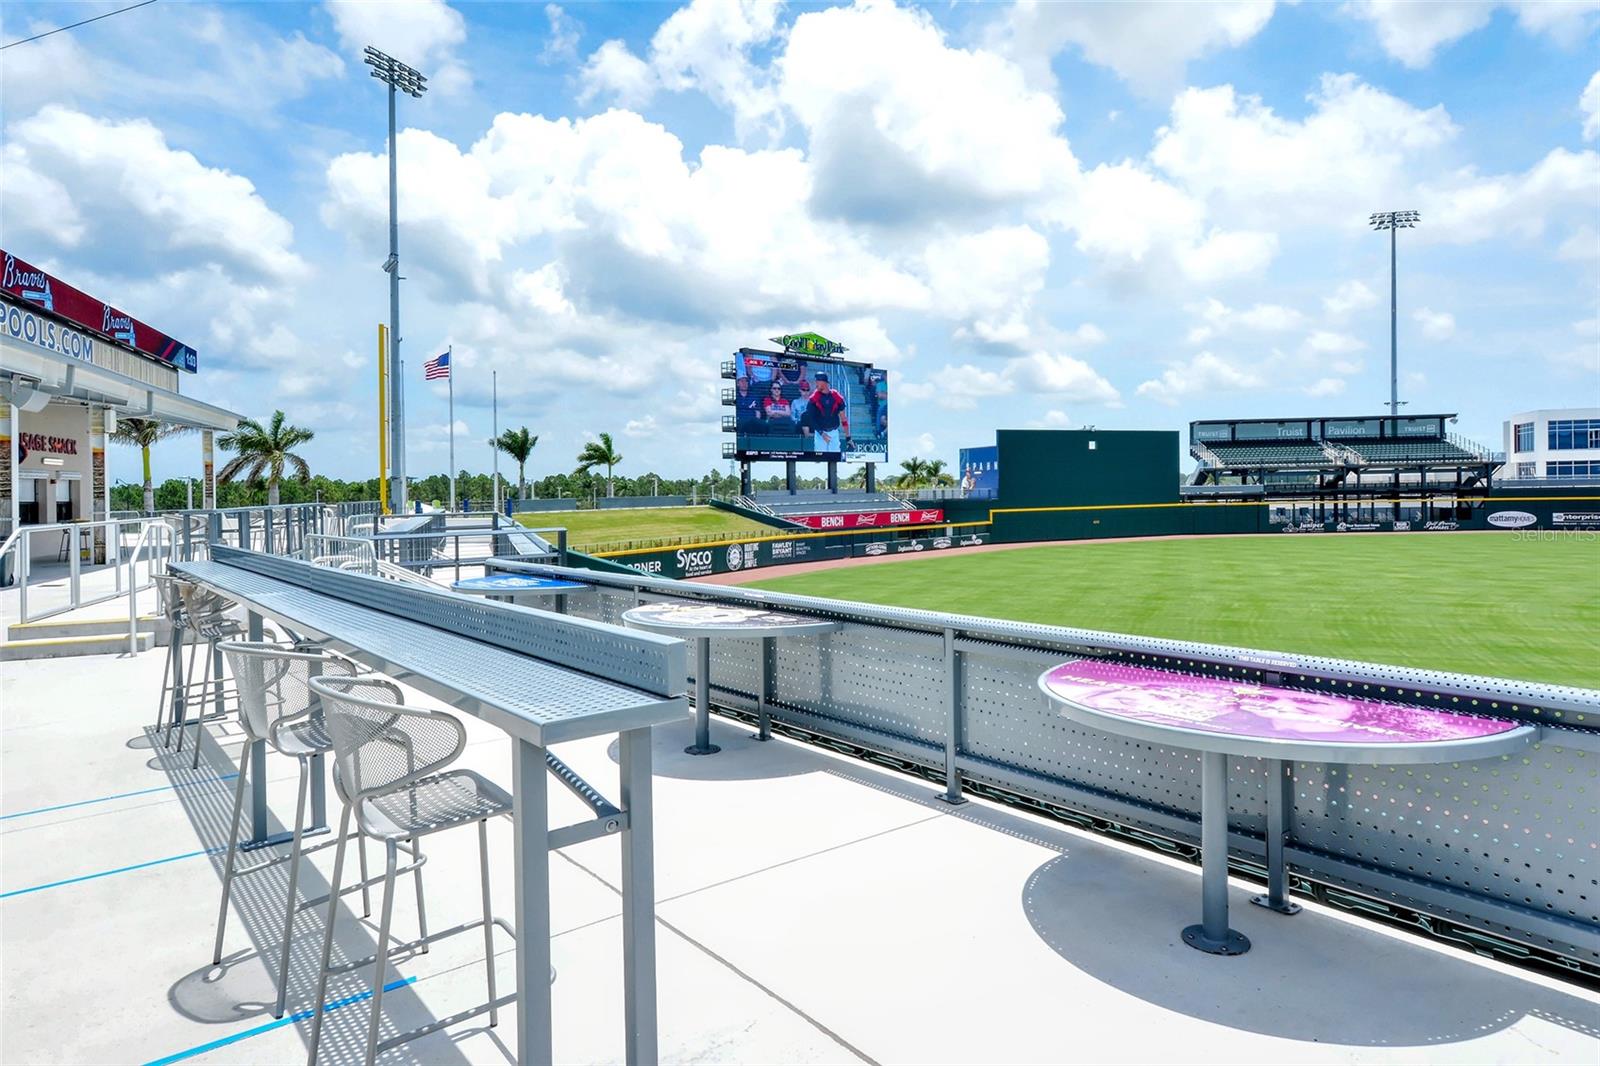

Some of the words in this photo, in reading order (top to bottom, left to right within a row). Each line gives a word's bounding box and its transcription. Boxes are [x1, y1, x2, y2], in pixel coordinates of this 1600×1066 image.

[3, 253, 46, 288] Braves
[1277, 427, 1304, 437] Truist
[1327, 426, 1366, 436] Pavilion
[48, 436, 77, 455] SHACK
[821, 515, 845, 528] BENCH
[890, 512, 910, 523] BENCH
[676, 548, 712, 570] Sysco
[1271, 659, 1297, 668] RESERVED
